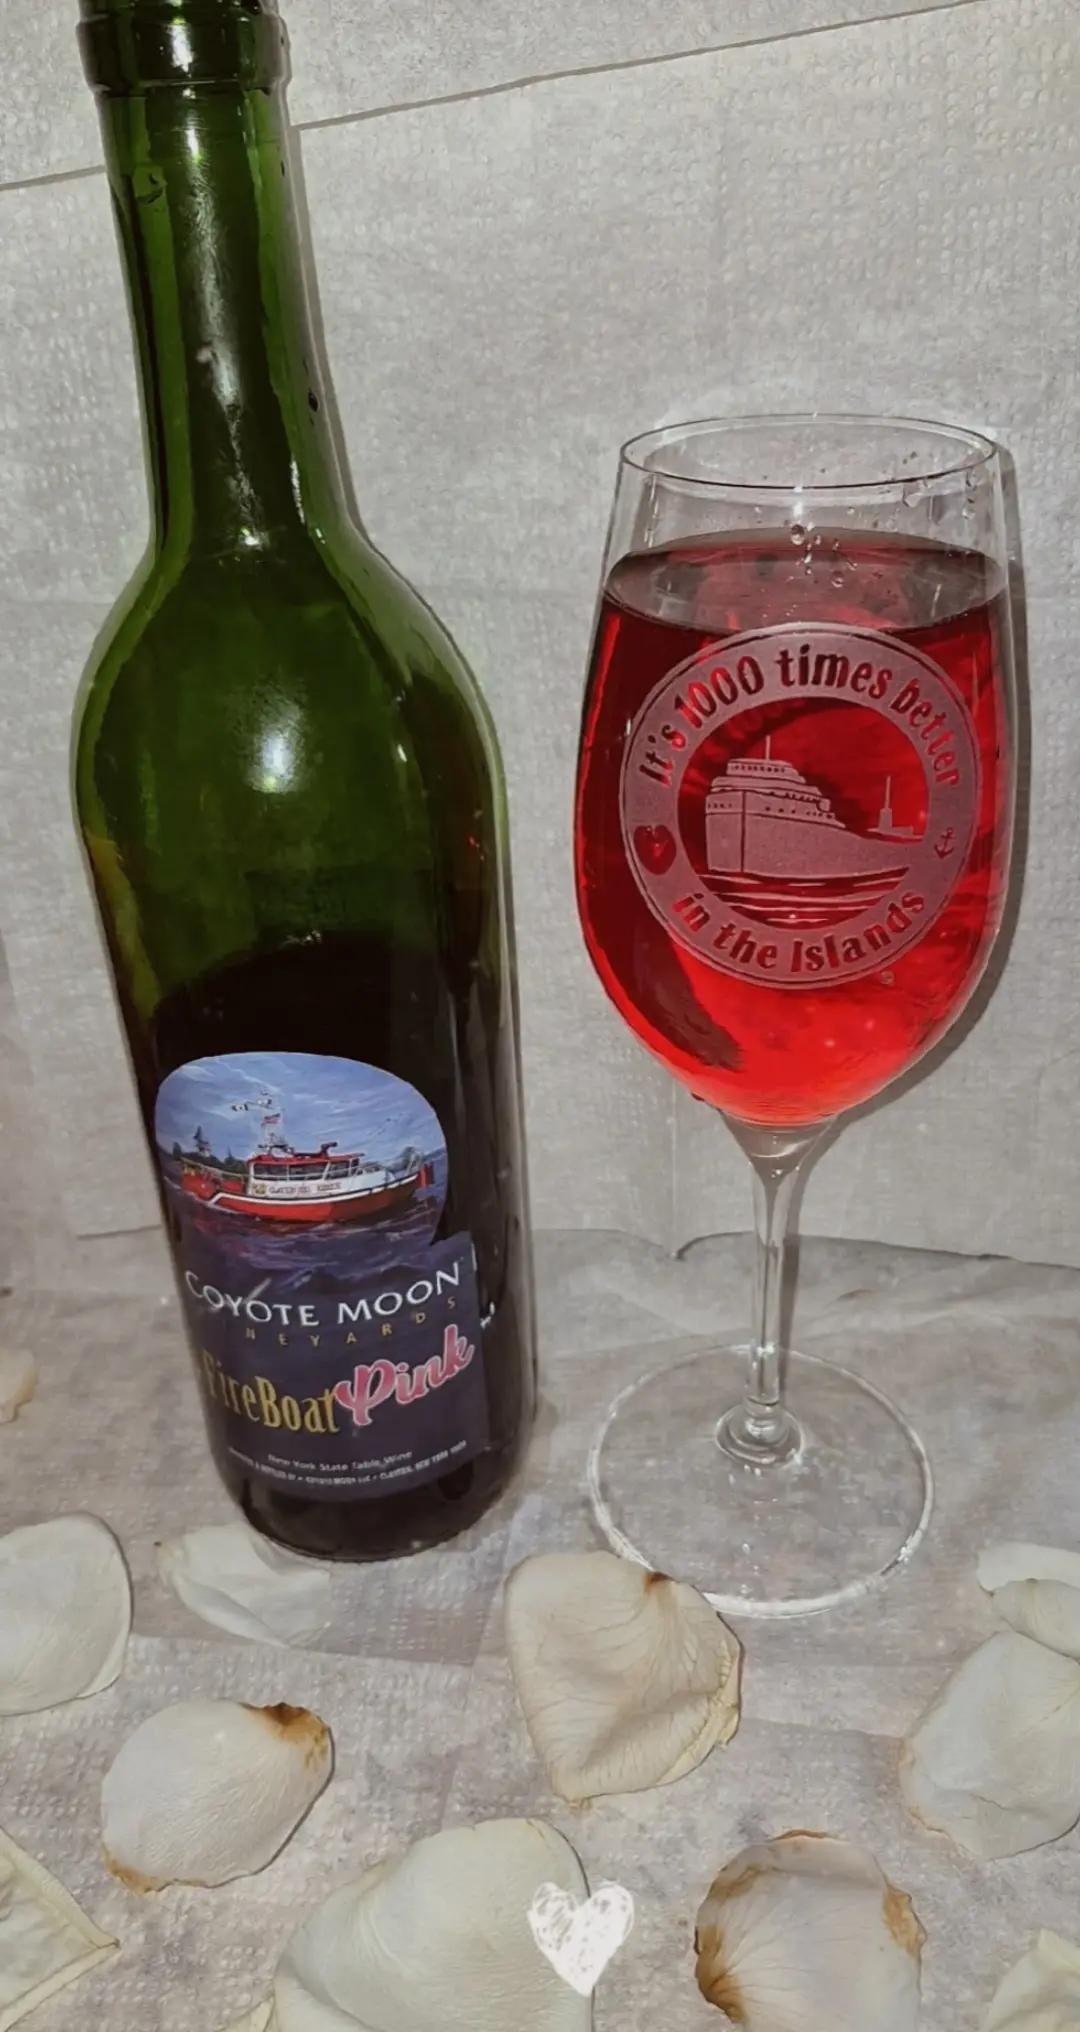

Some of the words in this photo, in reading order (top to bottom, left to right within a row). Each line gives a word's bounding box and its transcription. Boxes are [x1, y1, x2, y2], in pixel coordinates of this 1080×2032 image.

[640, 724, 687, 789] It's
[674, 655, 765, 730] 1000
[775, 644, 894, 700] times
[889, 678, 962, 787] better
[672, 892, 711, 933] in
[712, 922, 778, 969] the
[790, 891, 926, 973] Islands
[185, 1270, 319, 1327] COYOTE
[337, 1261, 460, 1324] MOON
[246, 1296, 456, 1347] NEYARDS
[201, 1349, 340, 1433] FireBoat
[334, 1323, 476, 1427] Pink
[319, 1462, 348, 1472] State
